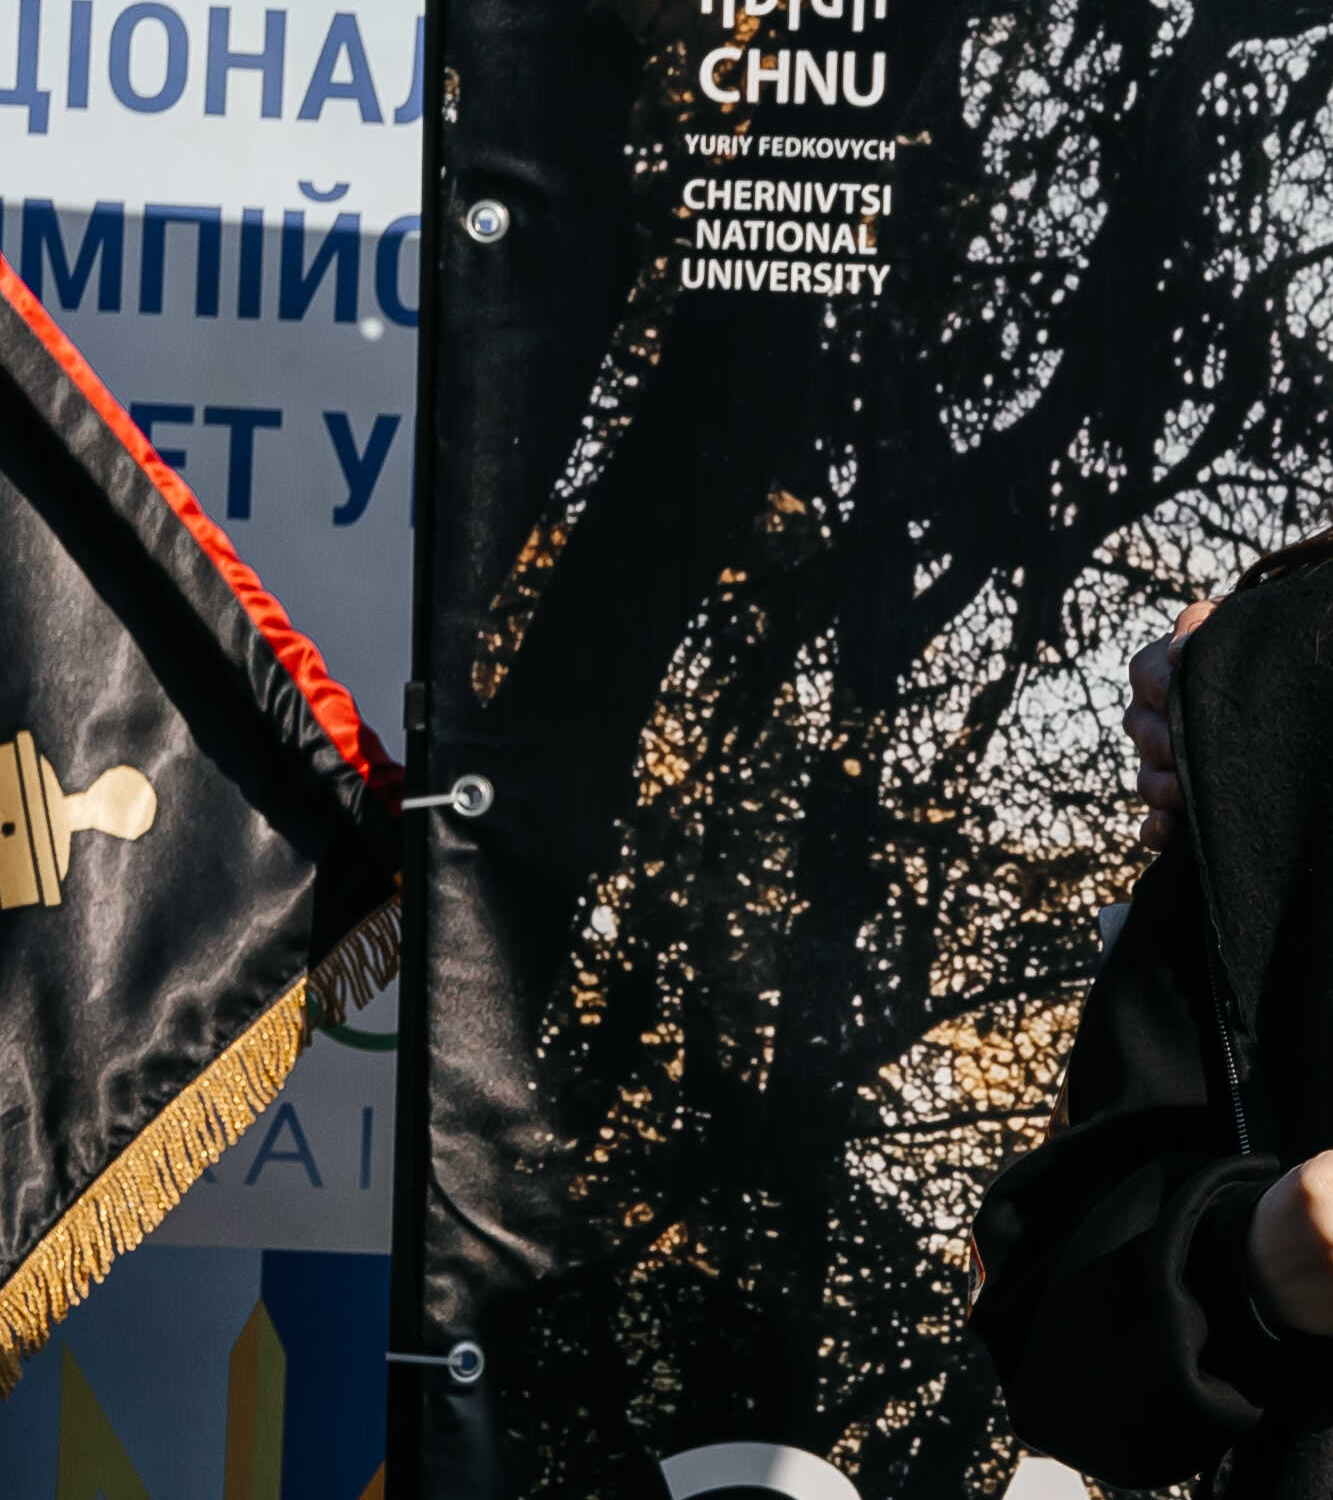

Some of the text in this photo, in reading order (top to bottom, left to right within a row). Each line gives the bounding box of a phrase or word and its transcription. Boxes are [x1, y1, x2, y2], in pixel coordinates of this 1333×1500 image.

[700, 46, 887, 107] CHNU
[685, 133, 896, 162] YURIY FEDKOVYCH
[682, 178, 892, 217] CHERNIVTSI
[696, 219, 878, 256] NATIONAL
[681, 258, 890, 296] UNIVERSITY
